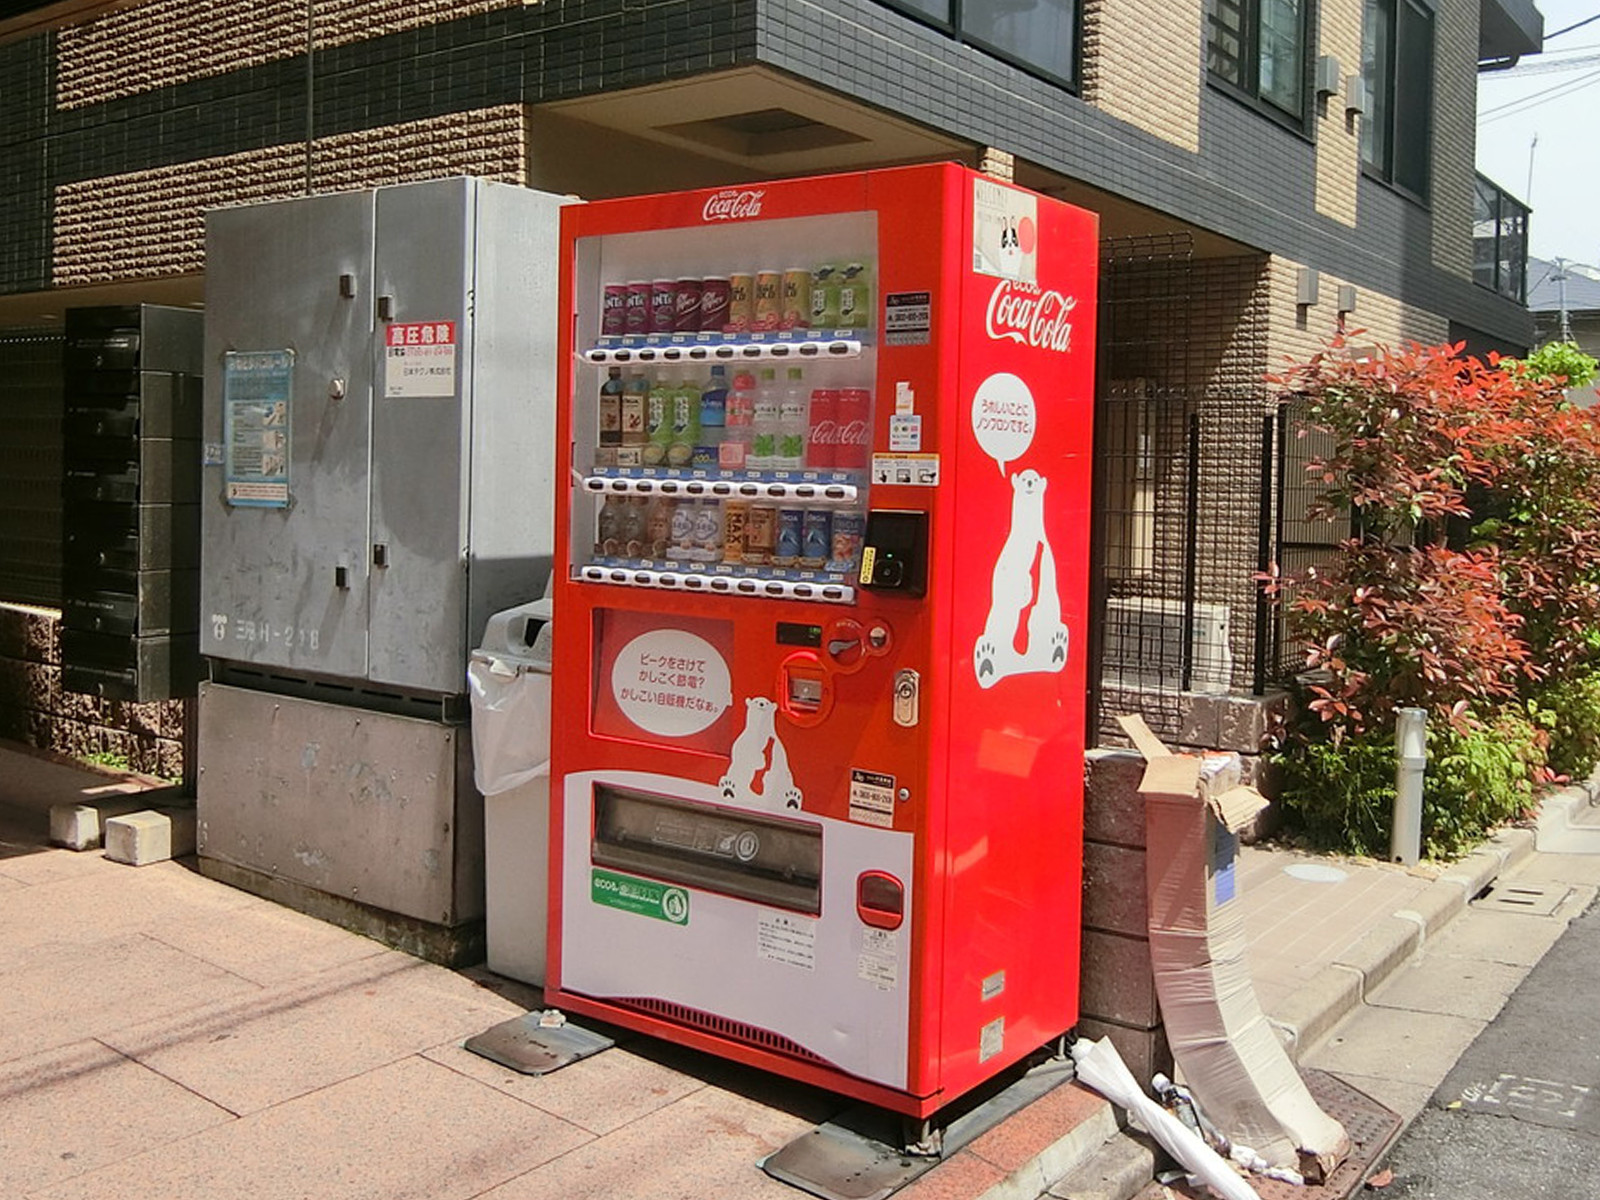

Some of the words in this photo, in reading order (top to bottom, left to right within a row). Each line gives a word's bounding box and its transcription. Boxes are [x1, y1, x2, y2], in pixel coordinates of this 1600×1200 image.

[703, 190, 767, 221] Coca-Cola
[985, 279, 1077, 353] Coca-Cola
[391, 324, 450, 345] 高圧危険
[981, 398, 1029, 417] うれしいことに
[640, 652, 706, 673] ピークをさけて
